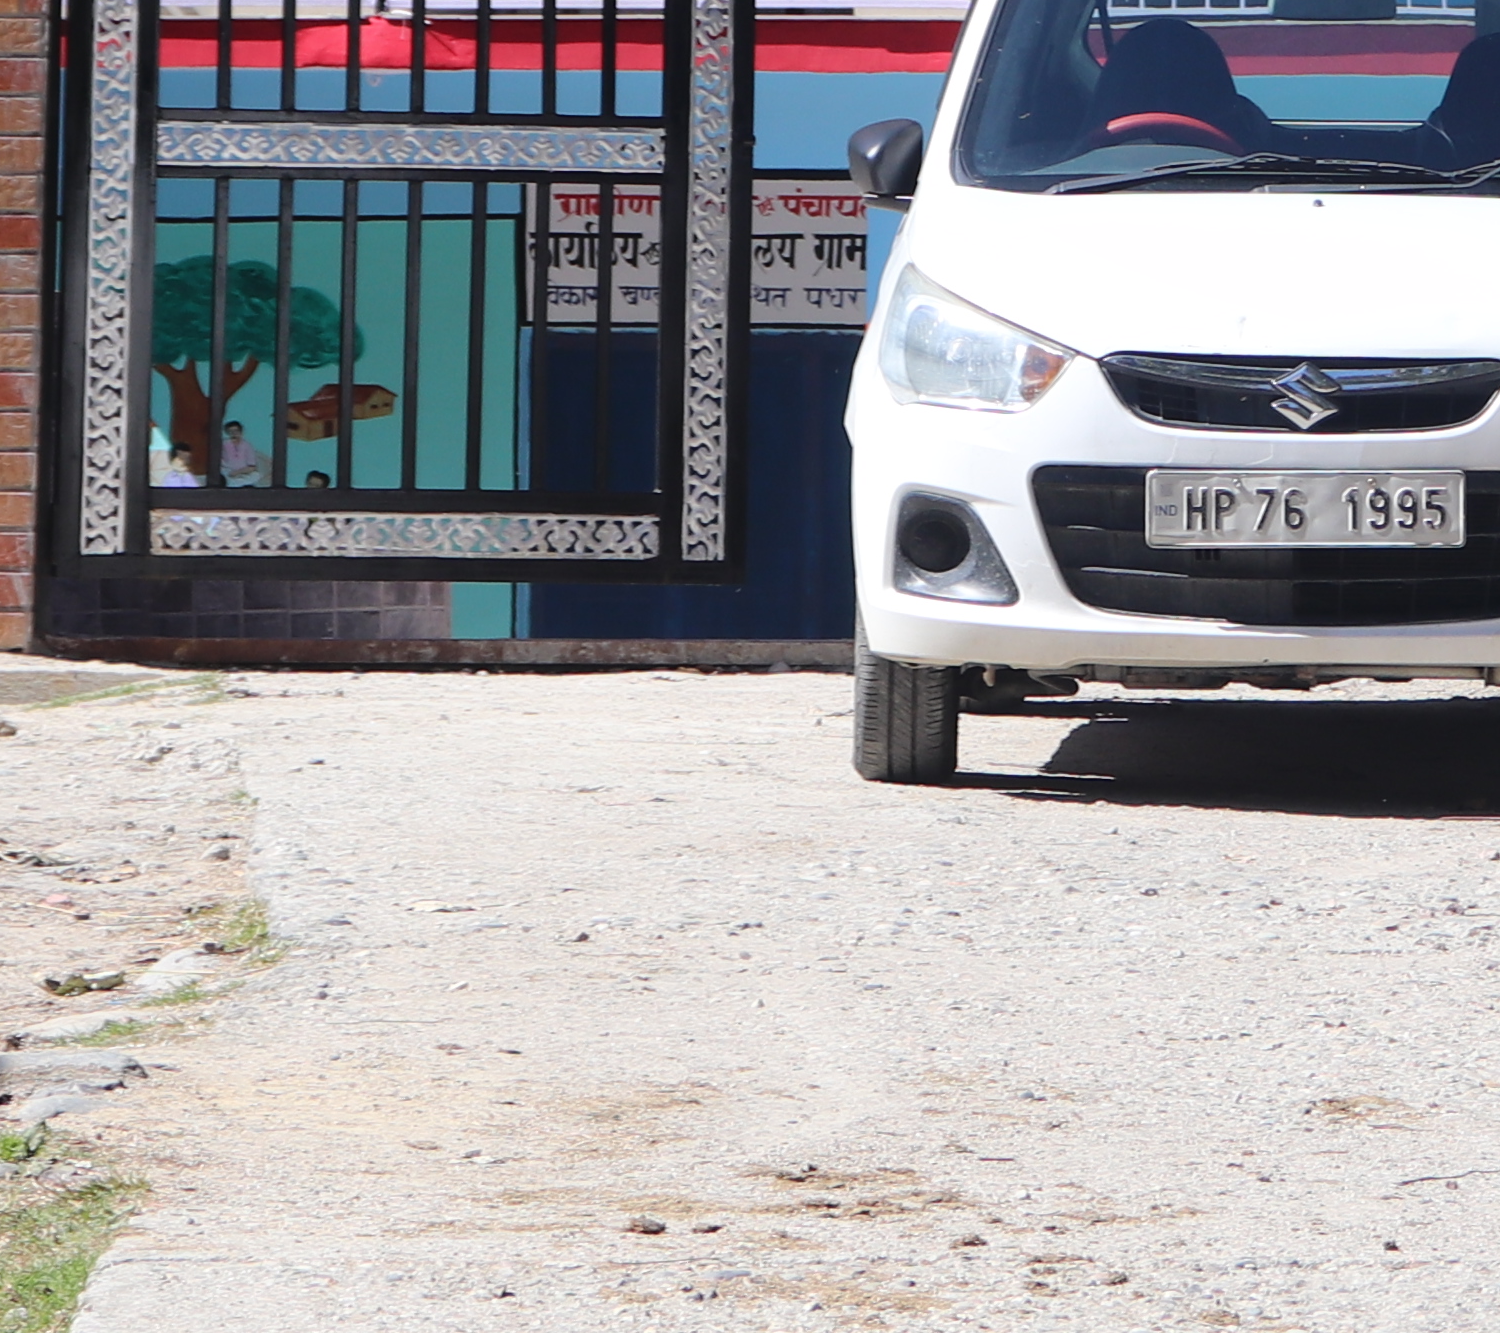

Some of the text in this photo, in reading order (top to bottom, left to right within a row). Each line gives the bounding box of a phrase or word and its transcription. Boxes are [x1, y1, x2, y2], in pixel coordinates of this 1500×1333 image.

[1154, 486, 1449, 532] IND HP 76 1995
